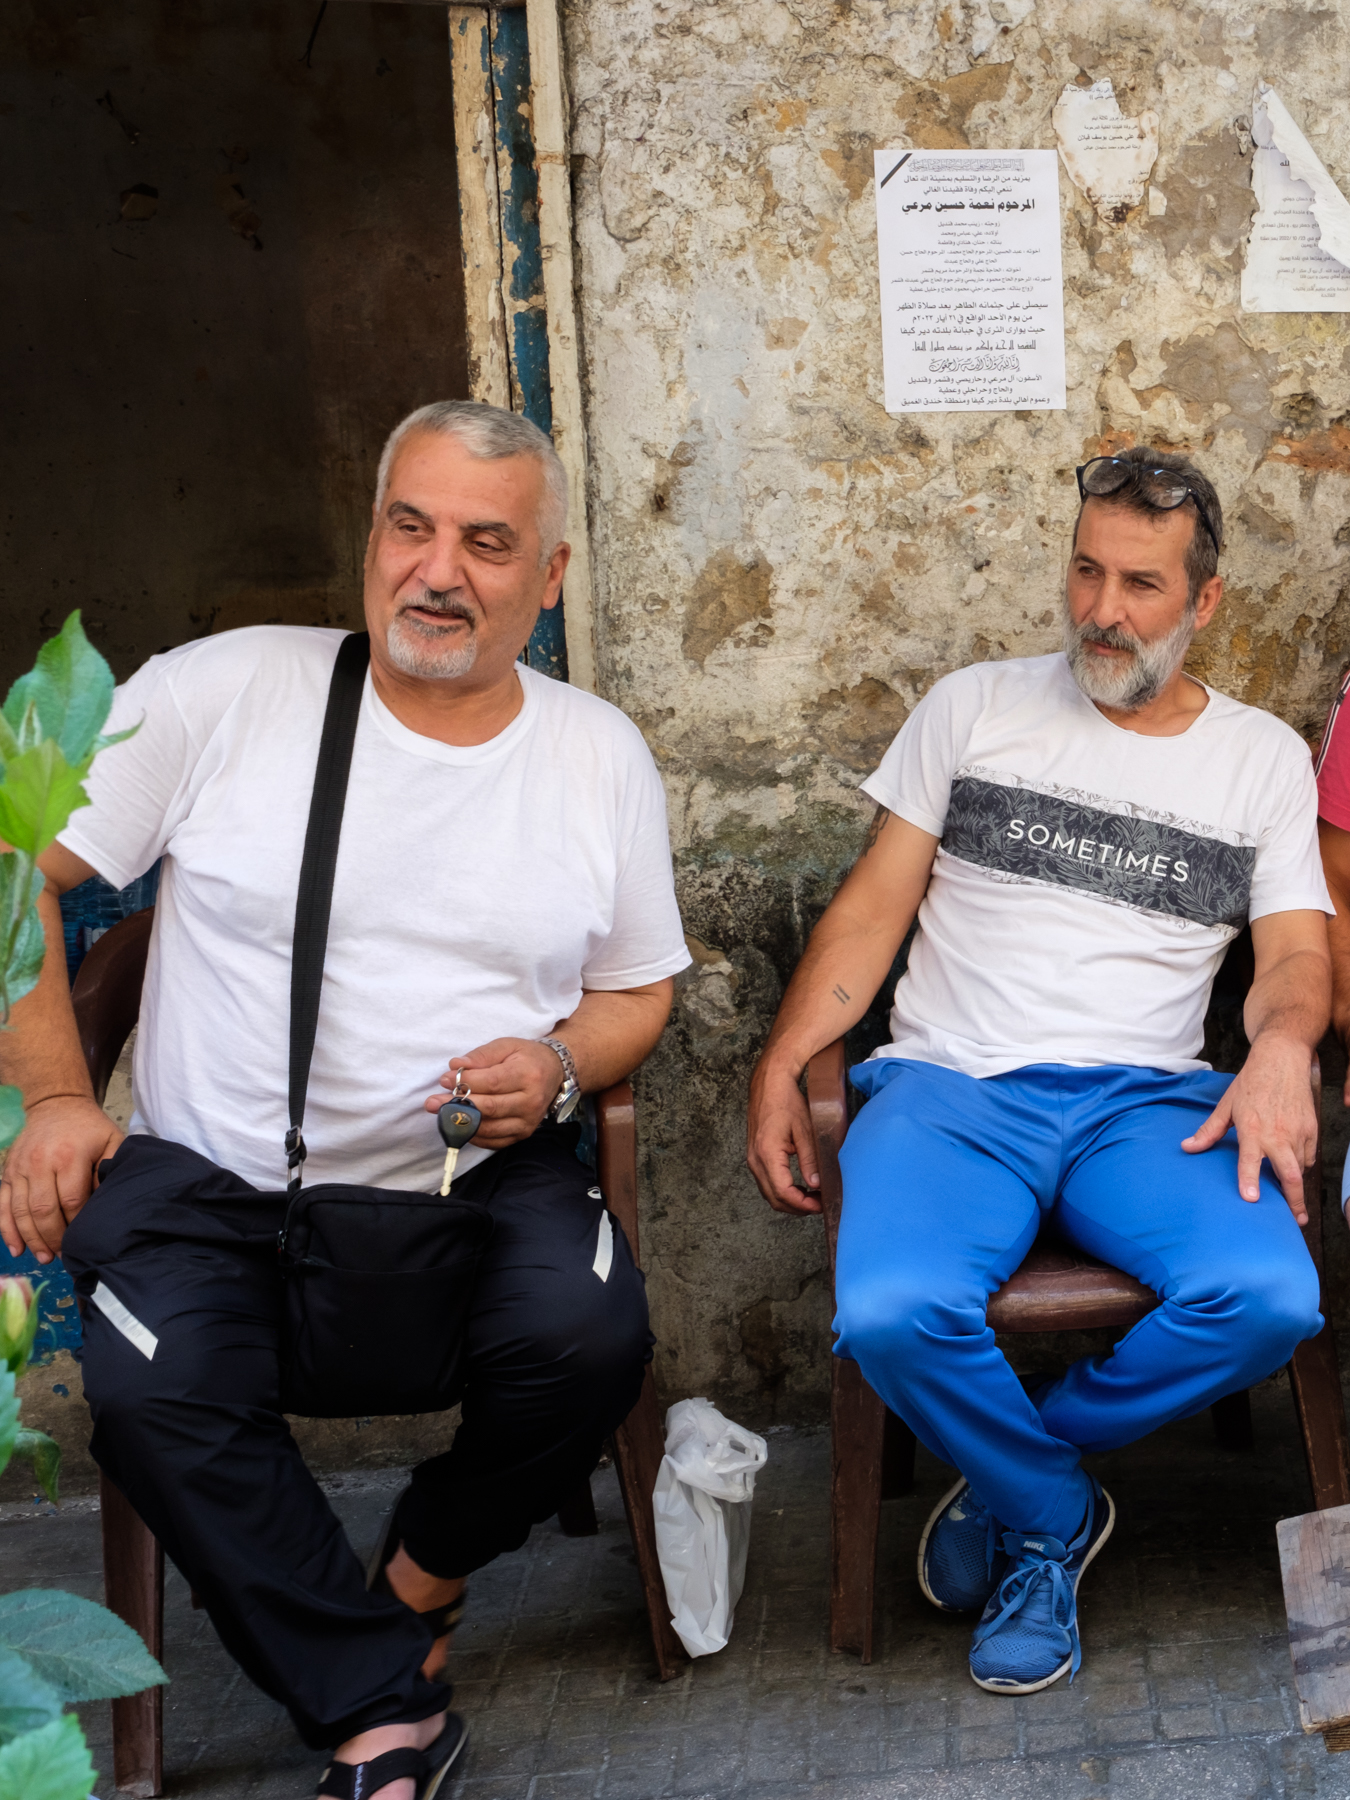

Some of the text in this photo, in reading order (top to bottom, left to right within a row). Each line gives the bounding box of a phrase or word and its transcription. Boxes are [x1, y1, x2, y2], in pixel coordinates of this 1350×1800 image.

[935, 201, 965, 212] حسين
[998, 199, 1035, 212] المرحوم
[1006, 819, 1190, 882] SOMETIMES
[1023, 1540, 1046, 1552] NIKE
